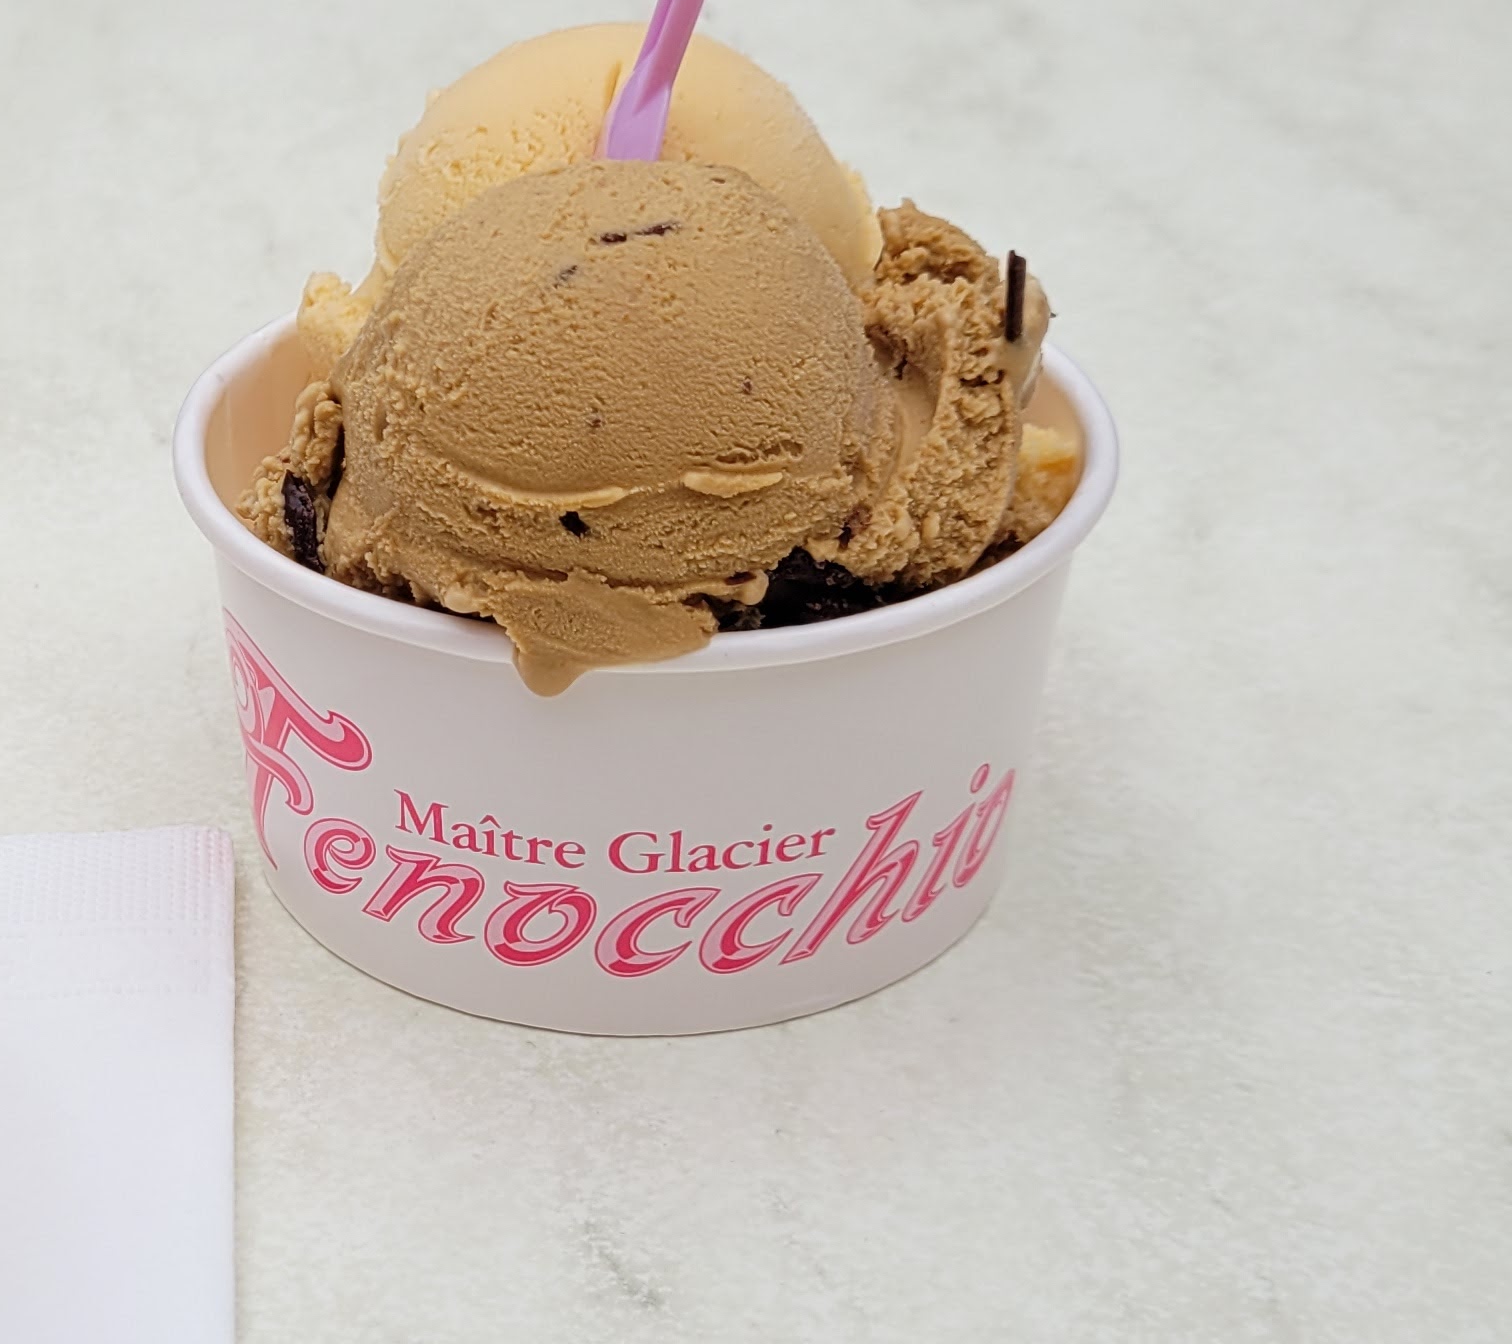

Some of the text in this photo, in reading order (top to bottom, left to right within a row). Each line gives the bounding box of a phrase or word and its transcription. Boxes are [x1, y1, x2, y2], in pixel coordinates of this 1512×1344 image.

[222, 606, 1016, 979] Fenocchio
[393, 788, 837, 874] Maître Glacier
